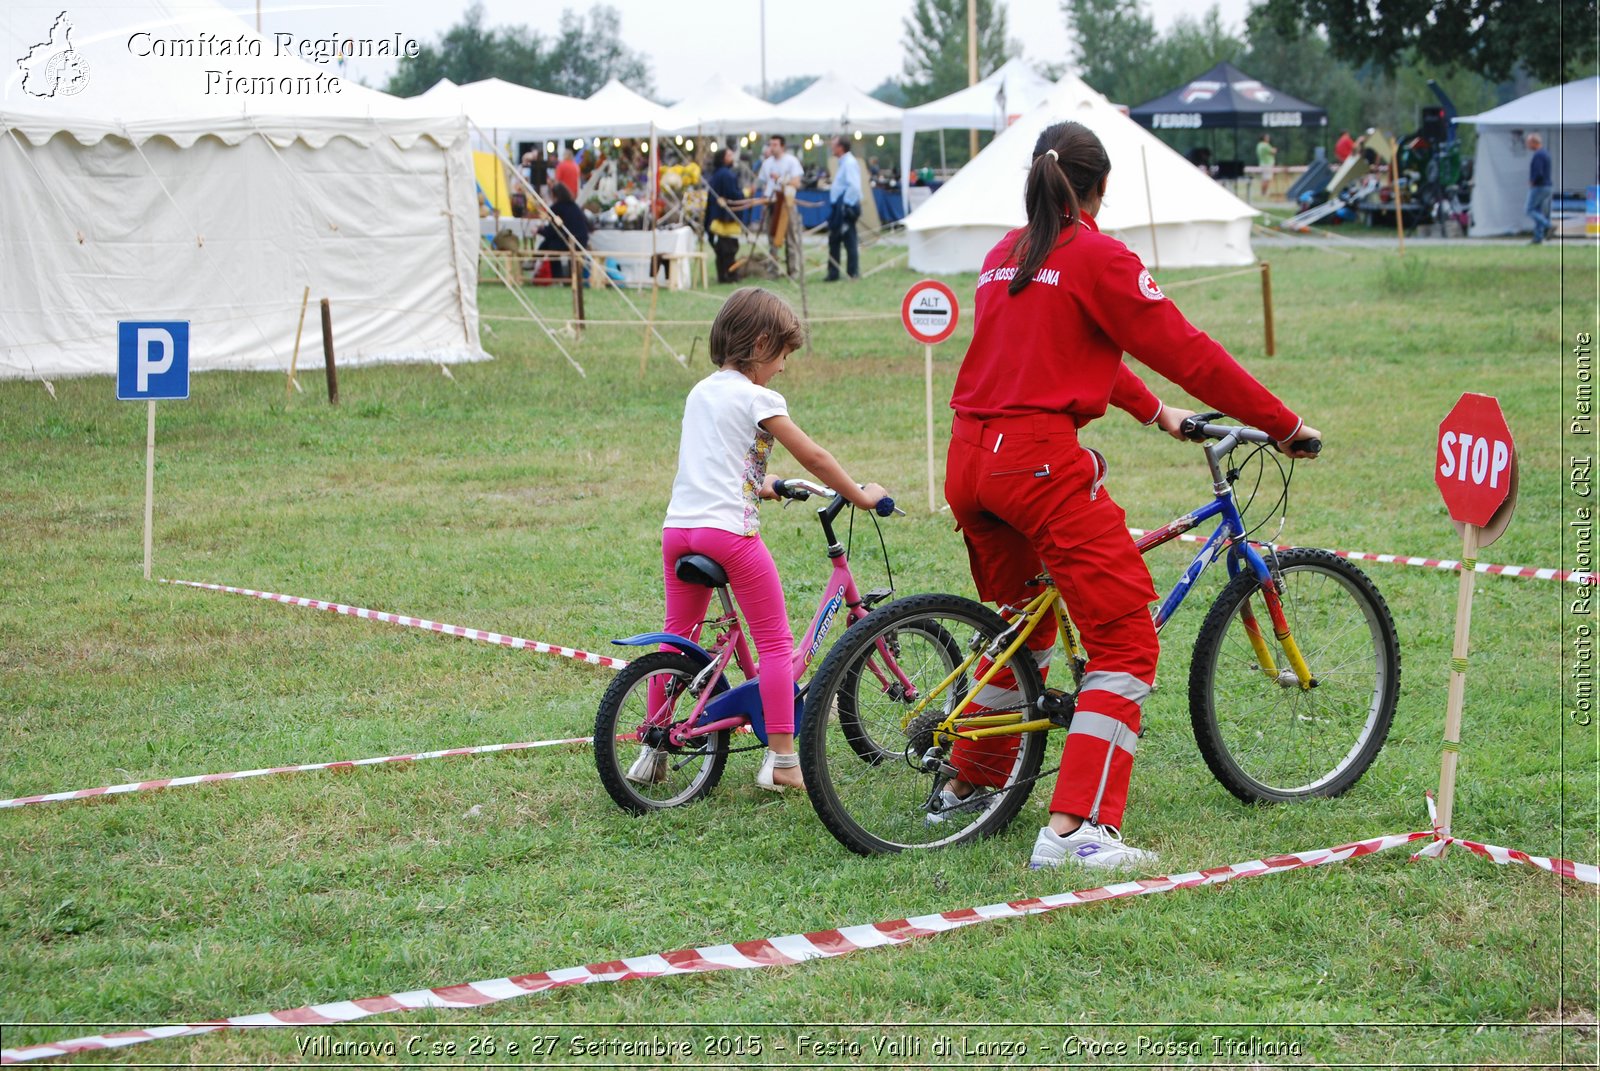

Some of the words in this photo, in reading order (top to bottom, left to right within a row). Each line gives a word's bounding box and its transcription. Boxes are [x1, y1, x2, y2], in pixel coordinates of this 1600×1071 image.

[1152, 113, 1203, 128] FERRIS
[1262, 112, 1302, 127] FERRIS
[920, 297, 940, 307] ALT
[136, 327, 175, 392] P
[1440, 431, 1508, 489] STOP
